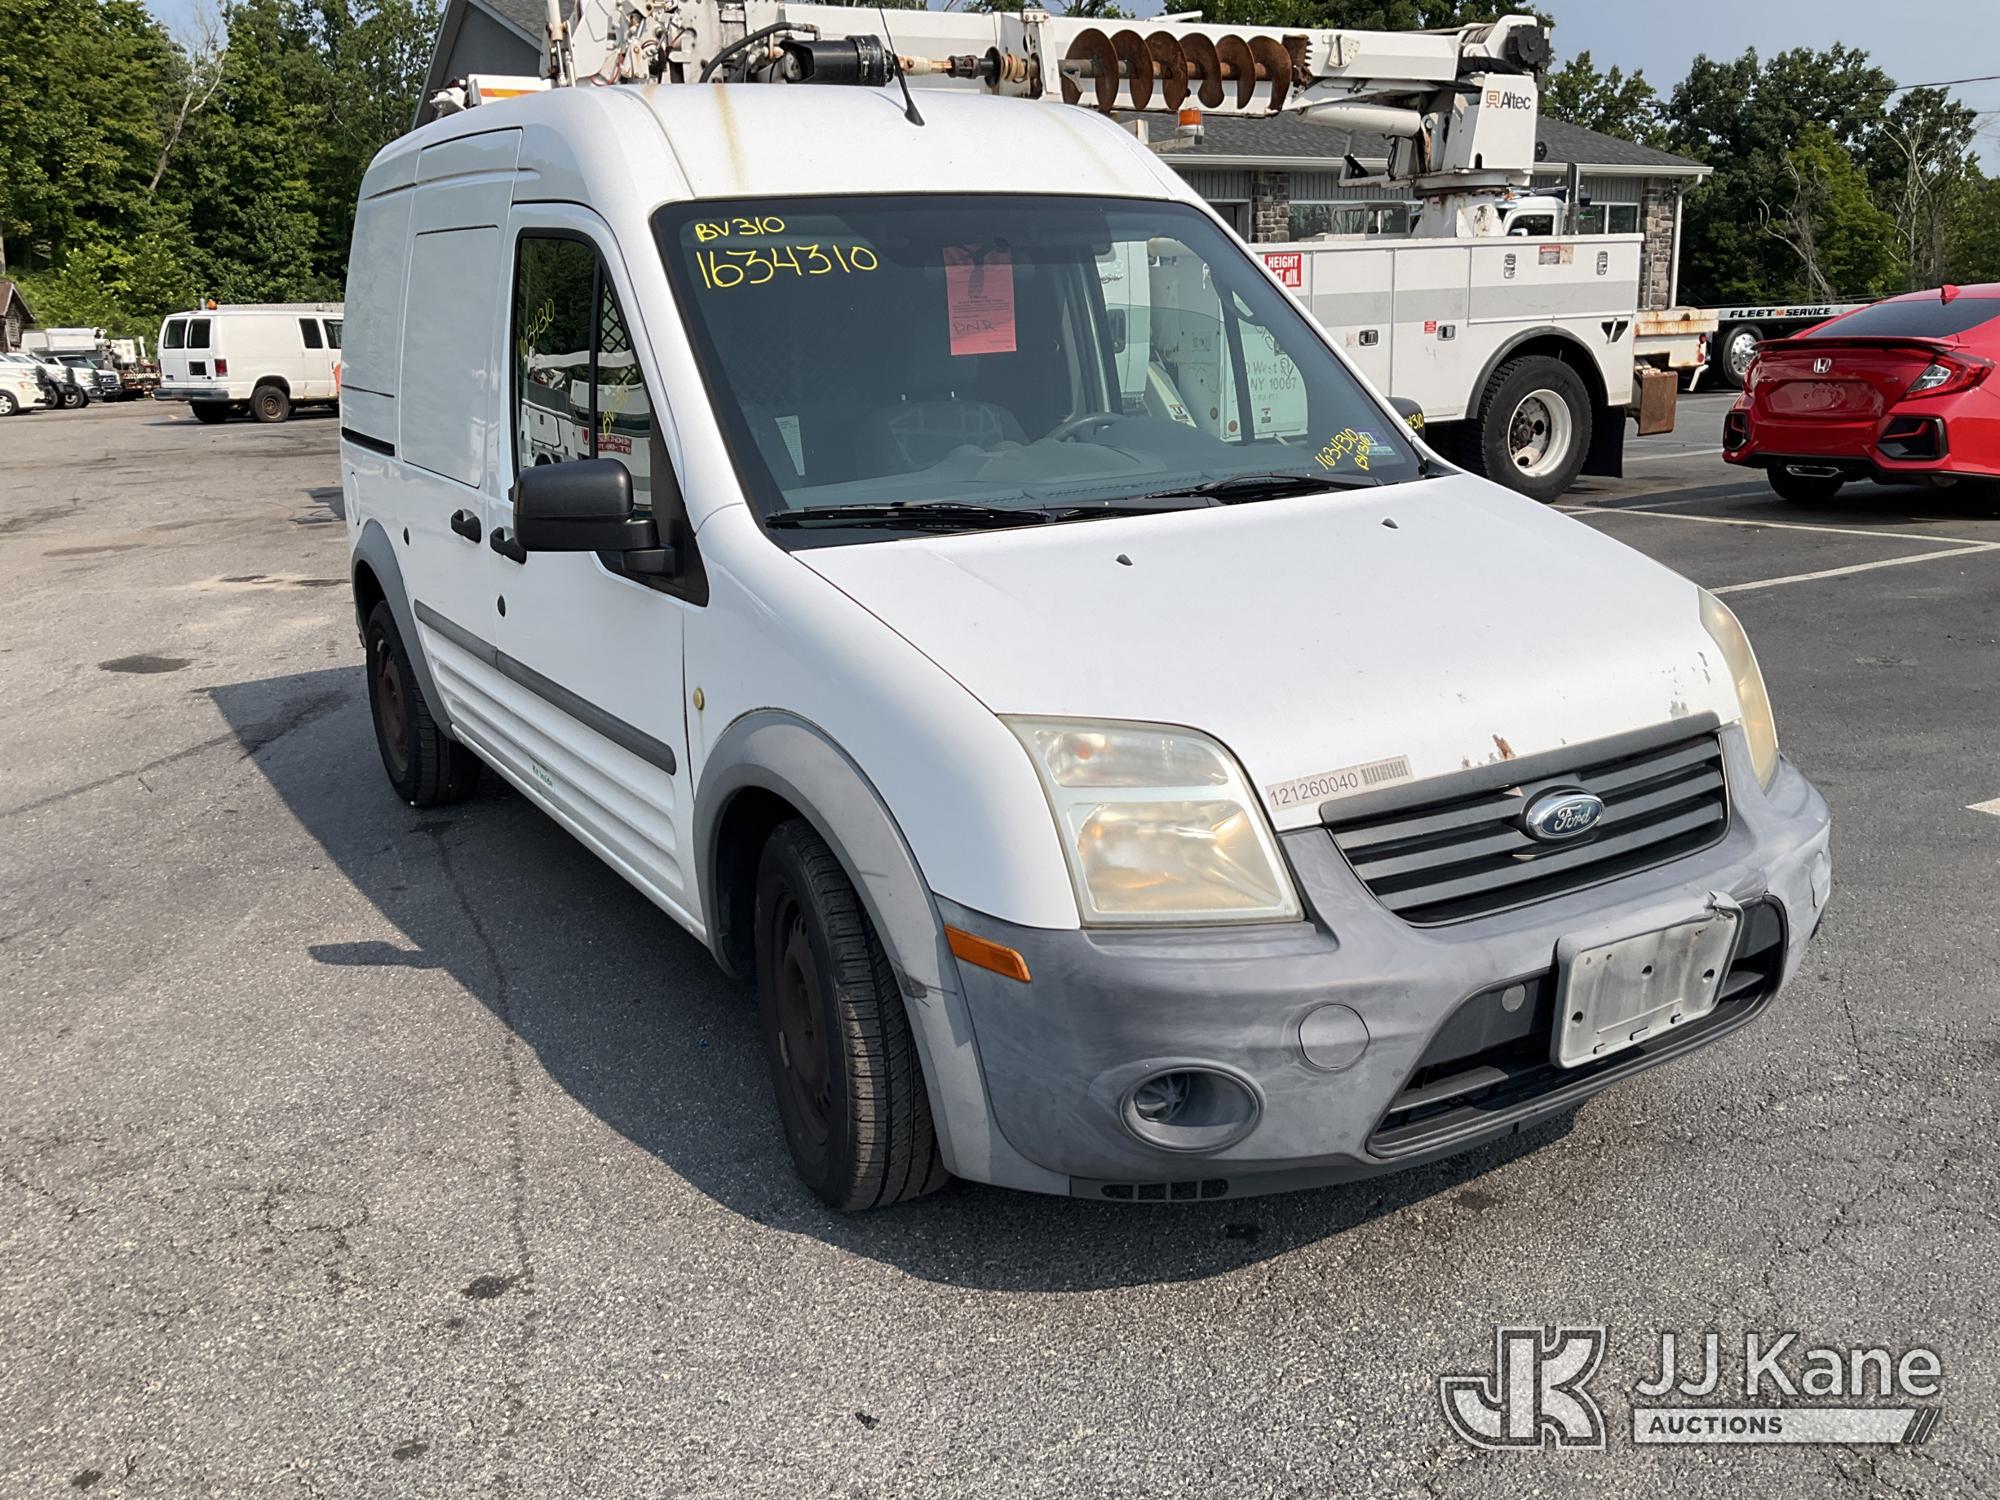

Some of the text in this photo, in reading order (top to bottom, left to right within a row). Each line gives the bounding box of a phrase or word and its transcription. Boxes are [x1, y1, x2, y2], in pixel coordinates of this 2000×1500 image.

[1500, 91, 1531, 110] Altec
[696, 244, 878, 289] 1634310
[1268, 255, 1299, 268] HEIGHT
[1729, 309, 1775, 318] FLEET
[1785, 307, 1831, 316] SERVICE
[1315, 428, 1359, 470] 1634310
[1270, 772, 1359, 806] 121260040
[1554, 803, 1592, 832] Ford
